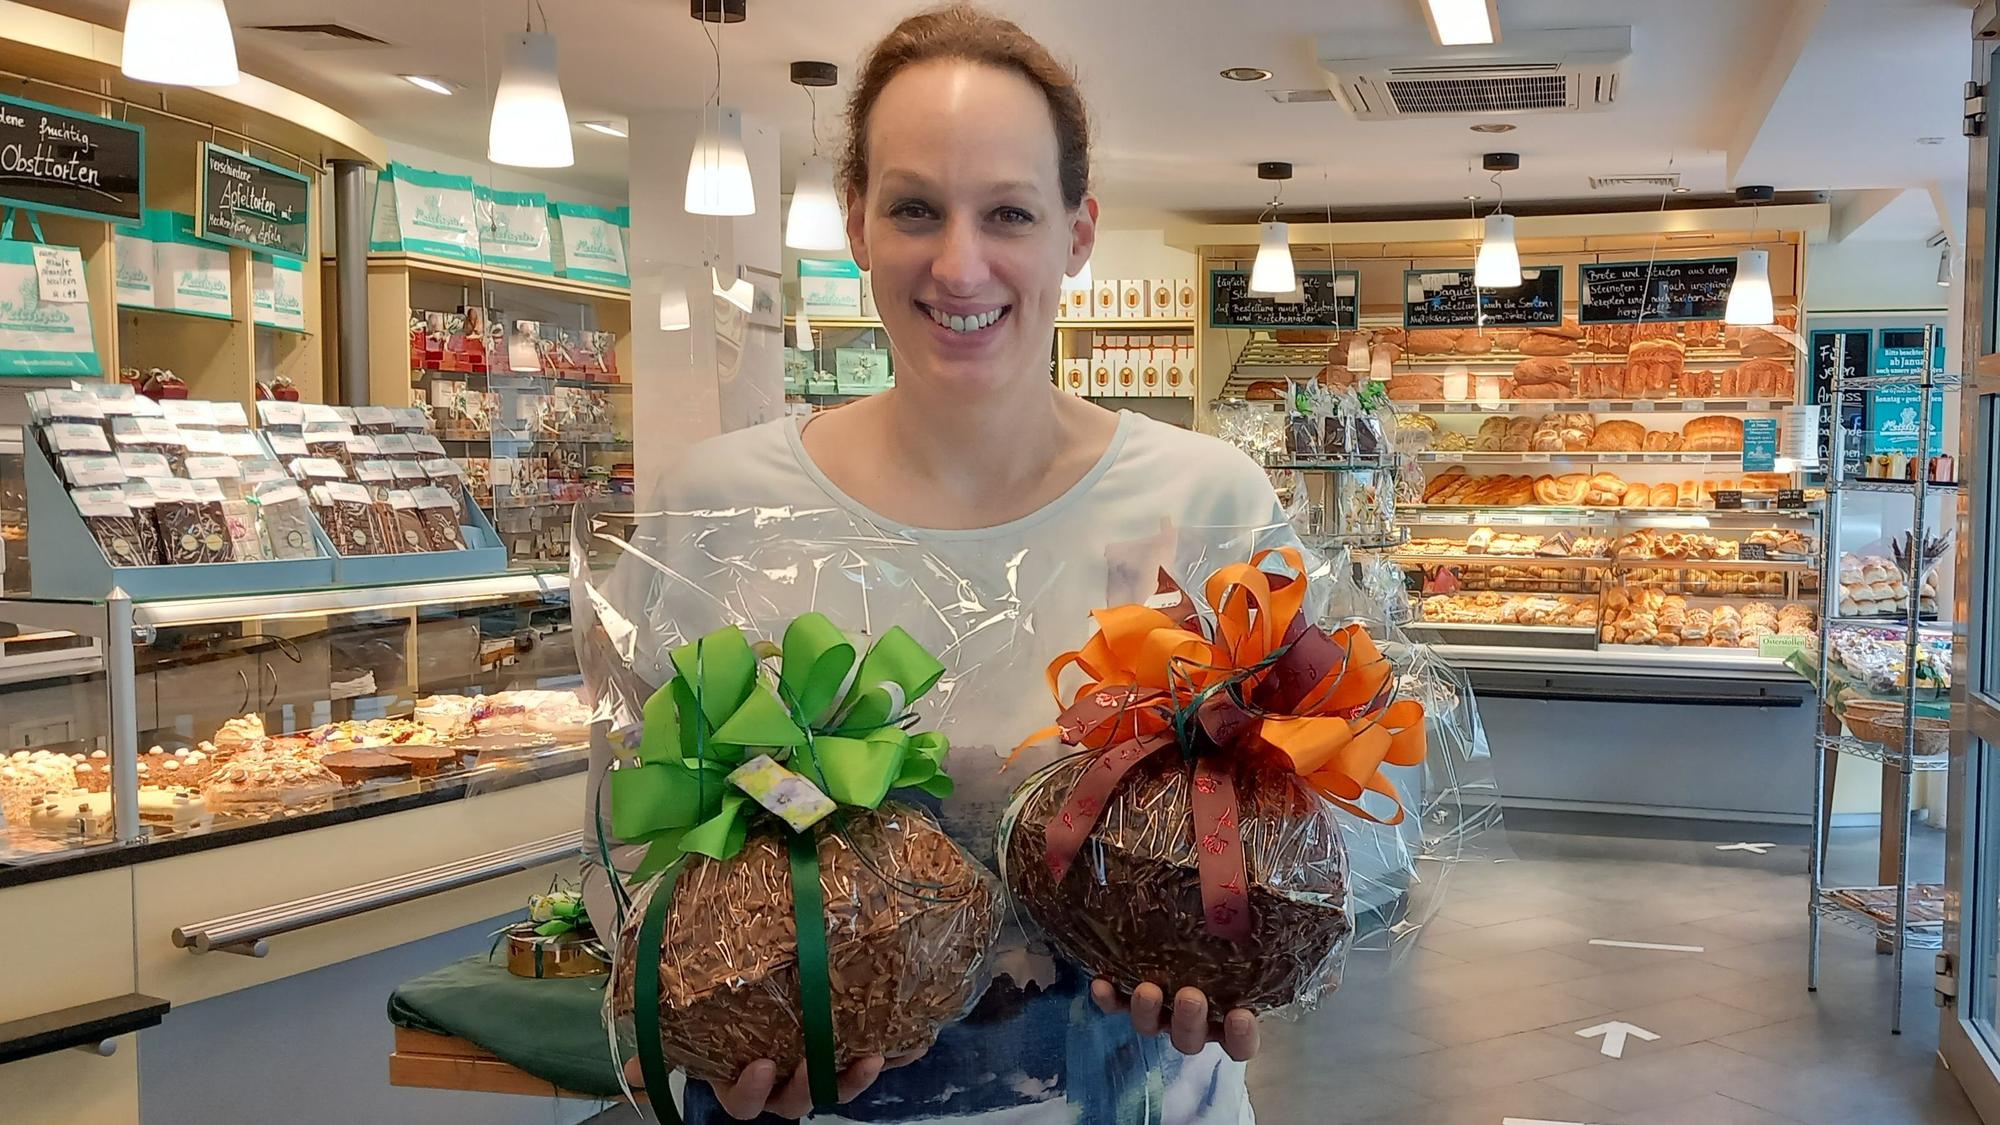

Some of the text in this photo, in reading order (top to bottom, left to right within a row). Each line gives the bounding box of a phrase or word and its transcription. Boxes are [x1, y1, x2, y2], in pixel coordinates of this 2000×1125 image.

[0, 143, 101, 186] Obsttorten
[209, 157, 252, 183] verschiedene
[219, 180, 278, 217] Apfeltorten
[1587, 268, 1617, 281] Brote
[1622, 267, 1641, 278] und
[1709, 265, 1728, 275] dem
[1433, 285, 1497, 301] Baguetes
[1432, 301, 1478, 312] Bestellun
[1889, 358, 1900, 366] ab
[1819, 364, 1856, 380] jeen
